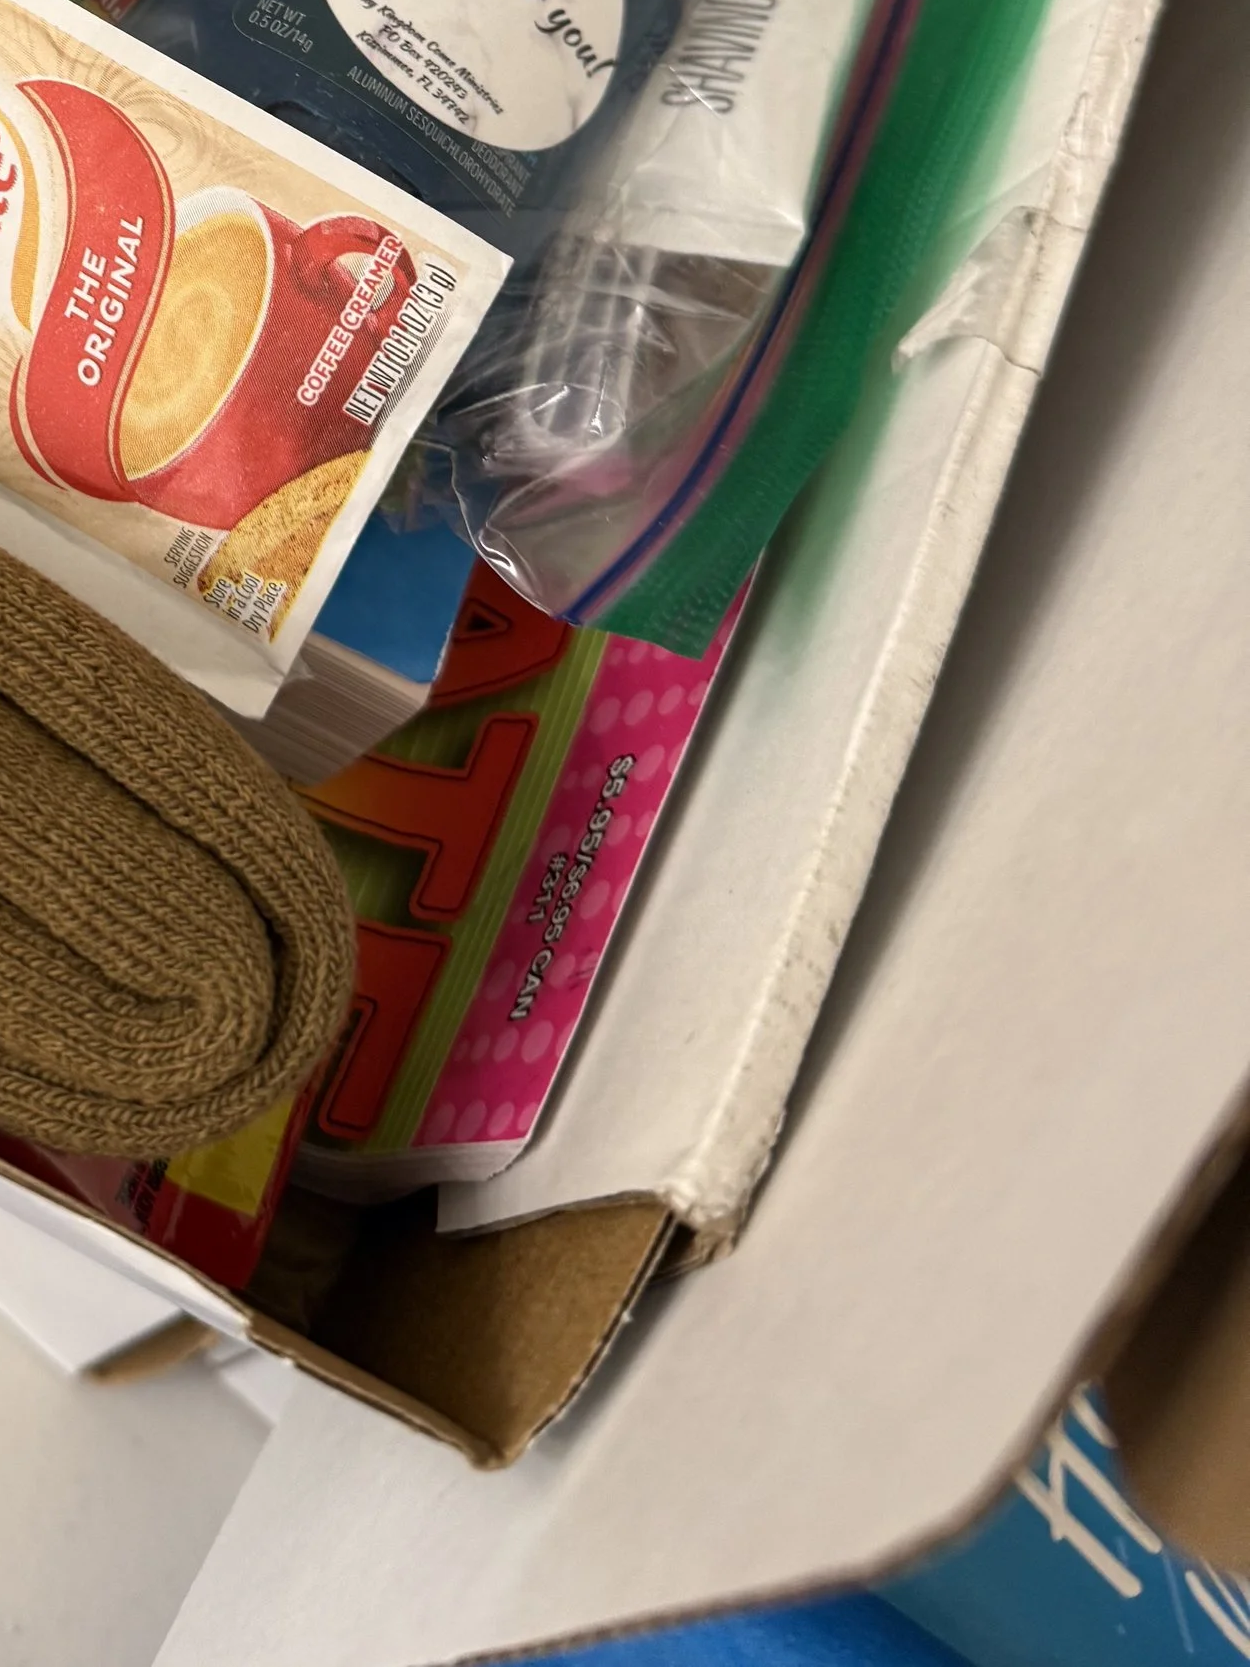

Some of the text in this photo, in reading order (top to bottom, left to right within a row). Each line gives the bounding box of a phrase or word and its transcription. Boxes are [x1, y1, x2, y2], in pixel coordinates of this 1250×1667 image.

[248, 9, 314, 54] 0.5 OZ/14g
[282, 5, 307, 26] WT
[376, 4, 428, 45] Kingdom
[426, 40, 457, 69] Come
[455, 66, 505, 116] Ministries
[378, 23, 402, 44] PO
[399, 37, 425, 63] Box
[534, 9, 617, 81] you!
[415, 73, 433, 93] FL
[346, 64, 408, 116] ALUMINUM
[404, 105, 517, 219] SESQUICHLOROHYDRATE
[63, 247, 109, 323] THE
[76, 215, 145, 387] ORIGINAL
[299, 237, 403, 405] COFFEE CREAMER
[398, 301, 434, 335] OZ
[381, 327, 420, 363] 0.1
[362, 353, 403, 391] WT
[344, 381, 384, 424] NET
[163, 525, 196, 568] SERVING
[172, 530, 215, 589] SUGGESTION
[202, 577, 232, 610] Store
[222, 605, 243, 622] in
[235, 570, 262, 600] Cool
[241, 580, 285, 634] Dry Place.
[508, 947, 554, 1021] CAN
